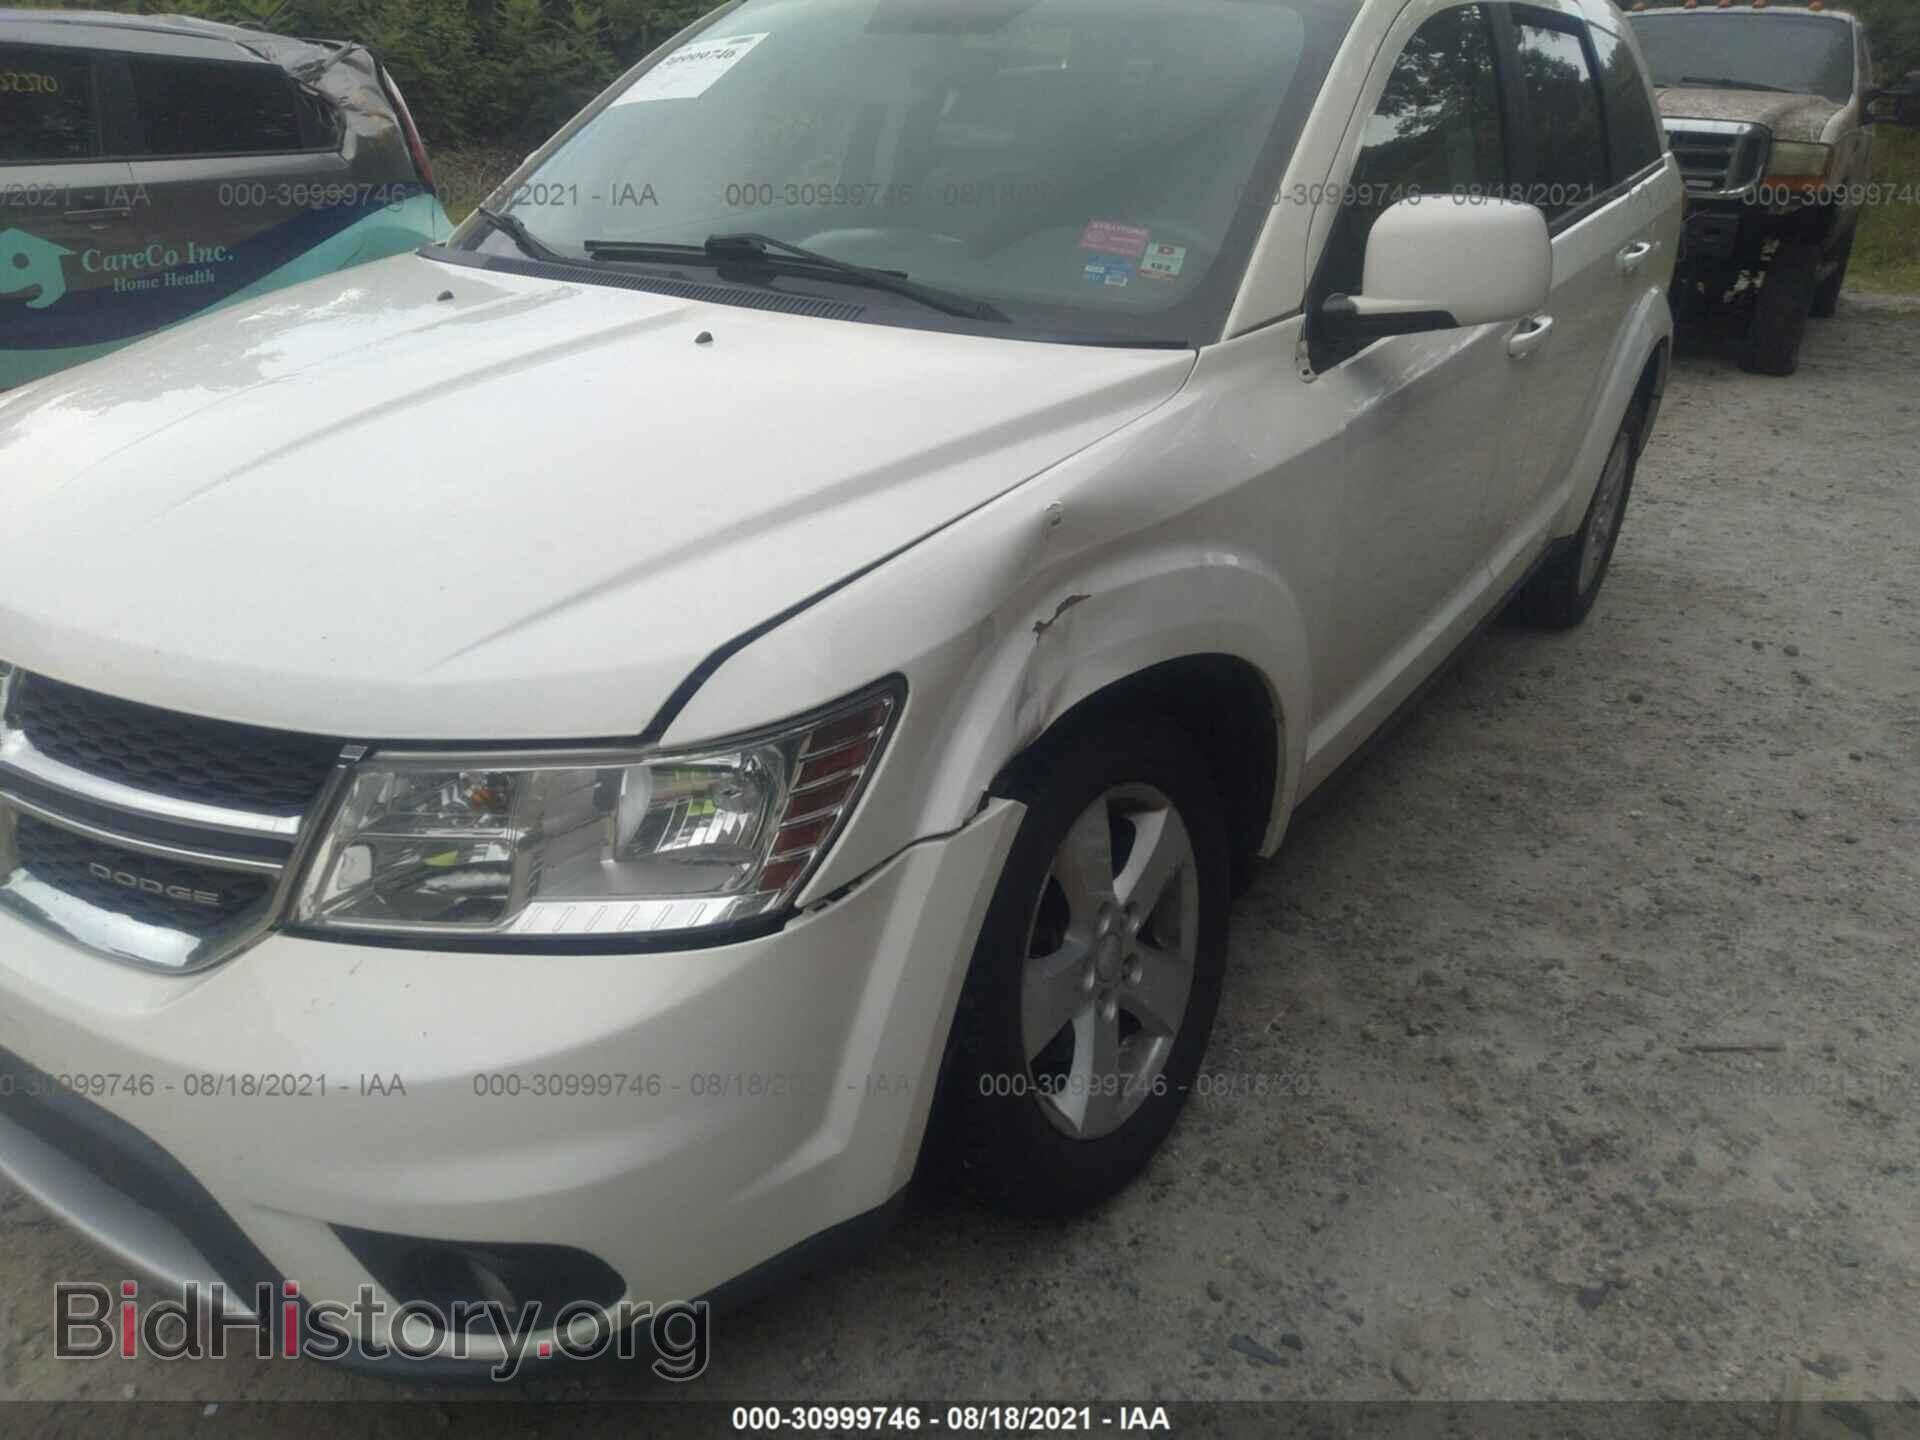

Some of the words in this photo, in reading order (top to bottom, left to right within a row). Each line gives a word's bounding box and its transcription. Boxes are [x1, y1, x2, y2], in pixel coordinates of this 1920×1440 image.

[82, 243, 179, 273] CareCo
[187, 241, 234, 265] Inc.
[113, 276, 161, 293] Home
[164, 269, 216, 288] Health
[89, 862, 221, 906] DODGE
